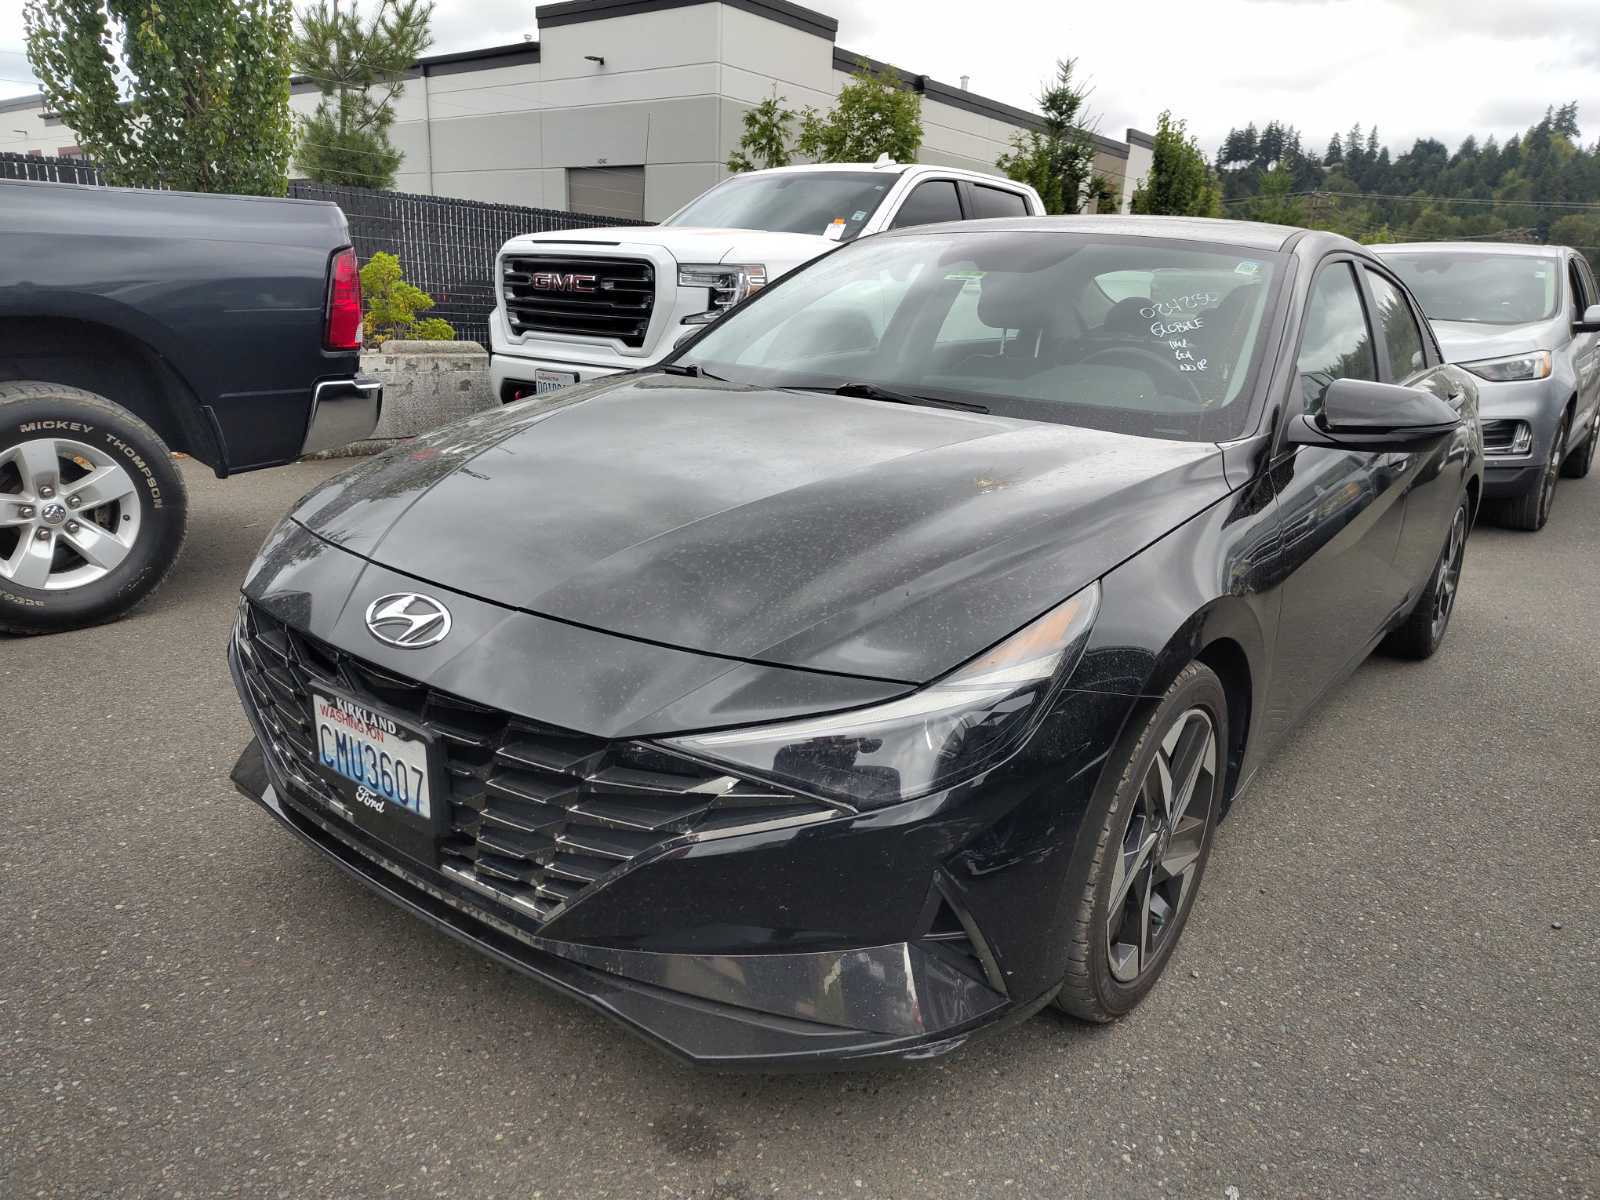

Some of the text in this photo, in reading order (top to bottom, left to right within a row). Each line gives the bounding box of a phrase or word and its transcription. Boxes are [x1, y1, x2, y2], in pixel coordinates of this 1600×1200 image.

[532, 272, 596, 293] GMC
[19, 420, 163, 510] MICKEY THOMPSON
[336, 697, 396, 734] KIRKLAND
[320, 723, 423, 813] CMU3607
[355, 785, 385, 813] Ford
